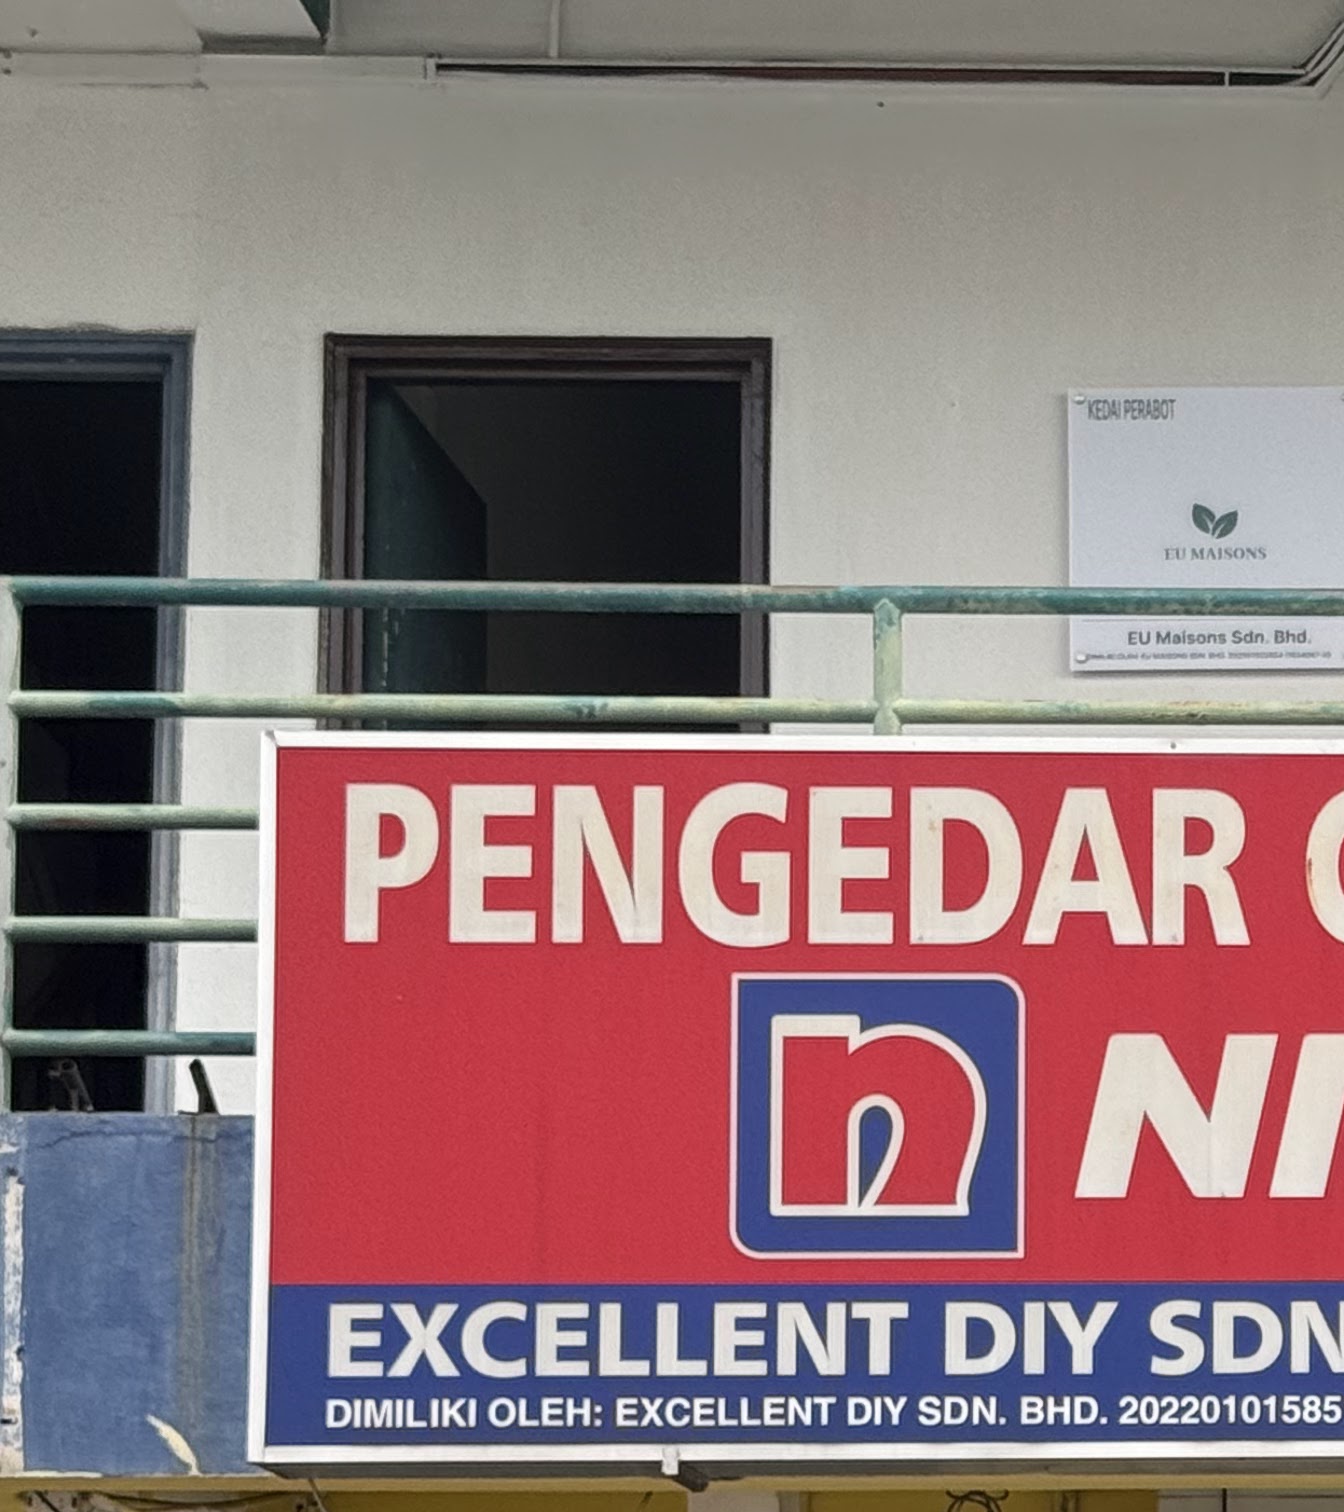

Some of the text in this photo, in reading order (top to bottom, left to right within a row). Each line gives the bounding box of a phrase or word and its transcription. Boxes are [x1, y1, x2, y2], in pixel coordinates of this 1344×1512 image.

[1087, 399, 1176, 420] KEDAI PERABOT
[1164, 546, 1267, 561] EU MAISONS
[1127, 629, 1312, 646] EU Maisons Sdn. Bhd.
[343, 783, 1252, 950] PENGEDAR
[326, 1300, 911, 1379] EXCELLENT
[944, 1300, 1118, 1376] DIY
[325, 1396, 477, 1430] DIMILIKI
[487, 1396, 603, 1429] OLEH:
[615, 1396, 837, 1428] EXCELLENT
[847, 1396, 908, 1427] DIY
[917, 1395, 1007, 1427] SDN.
[1019, 1395, 1108, 1426] BHD.
